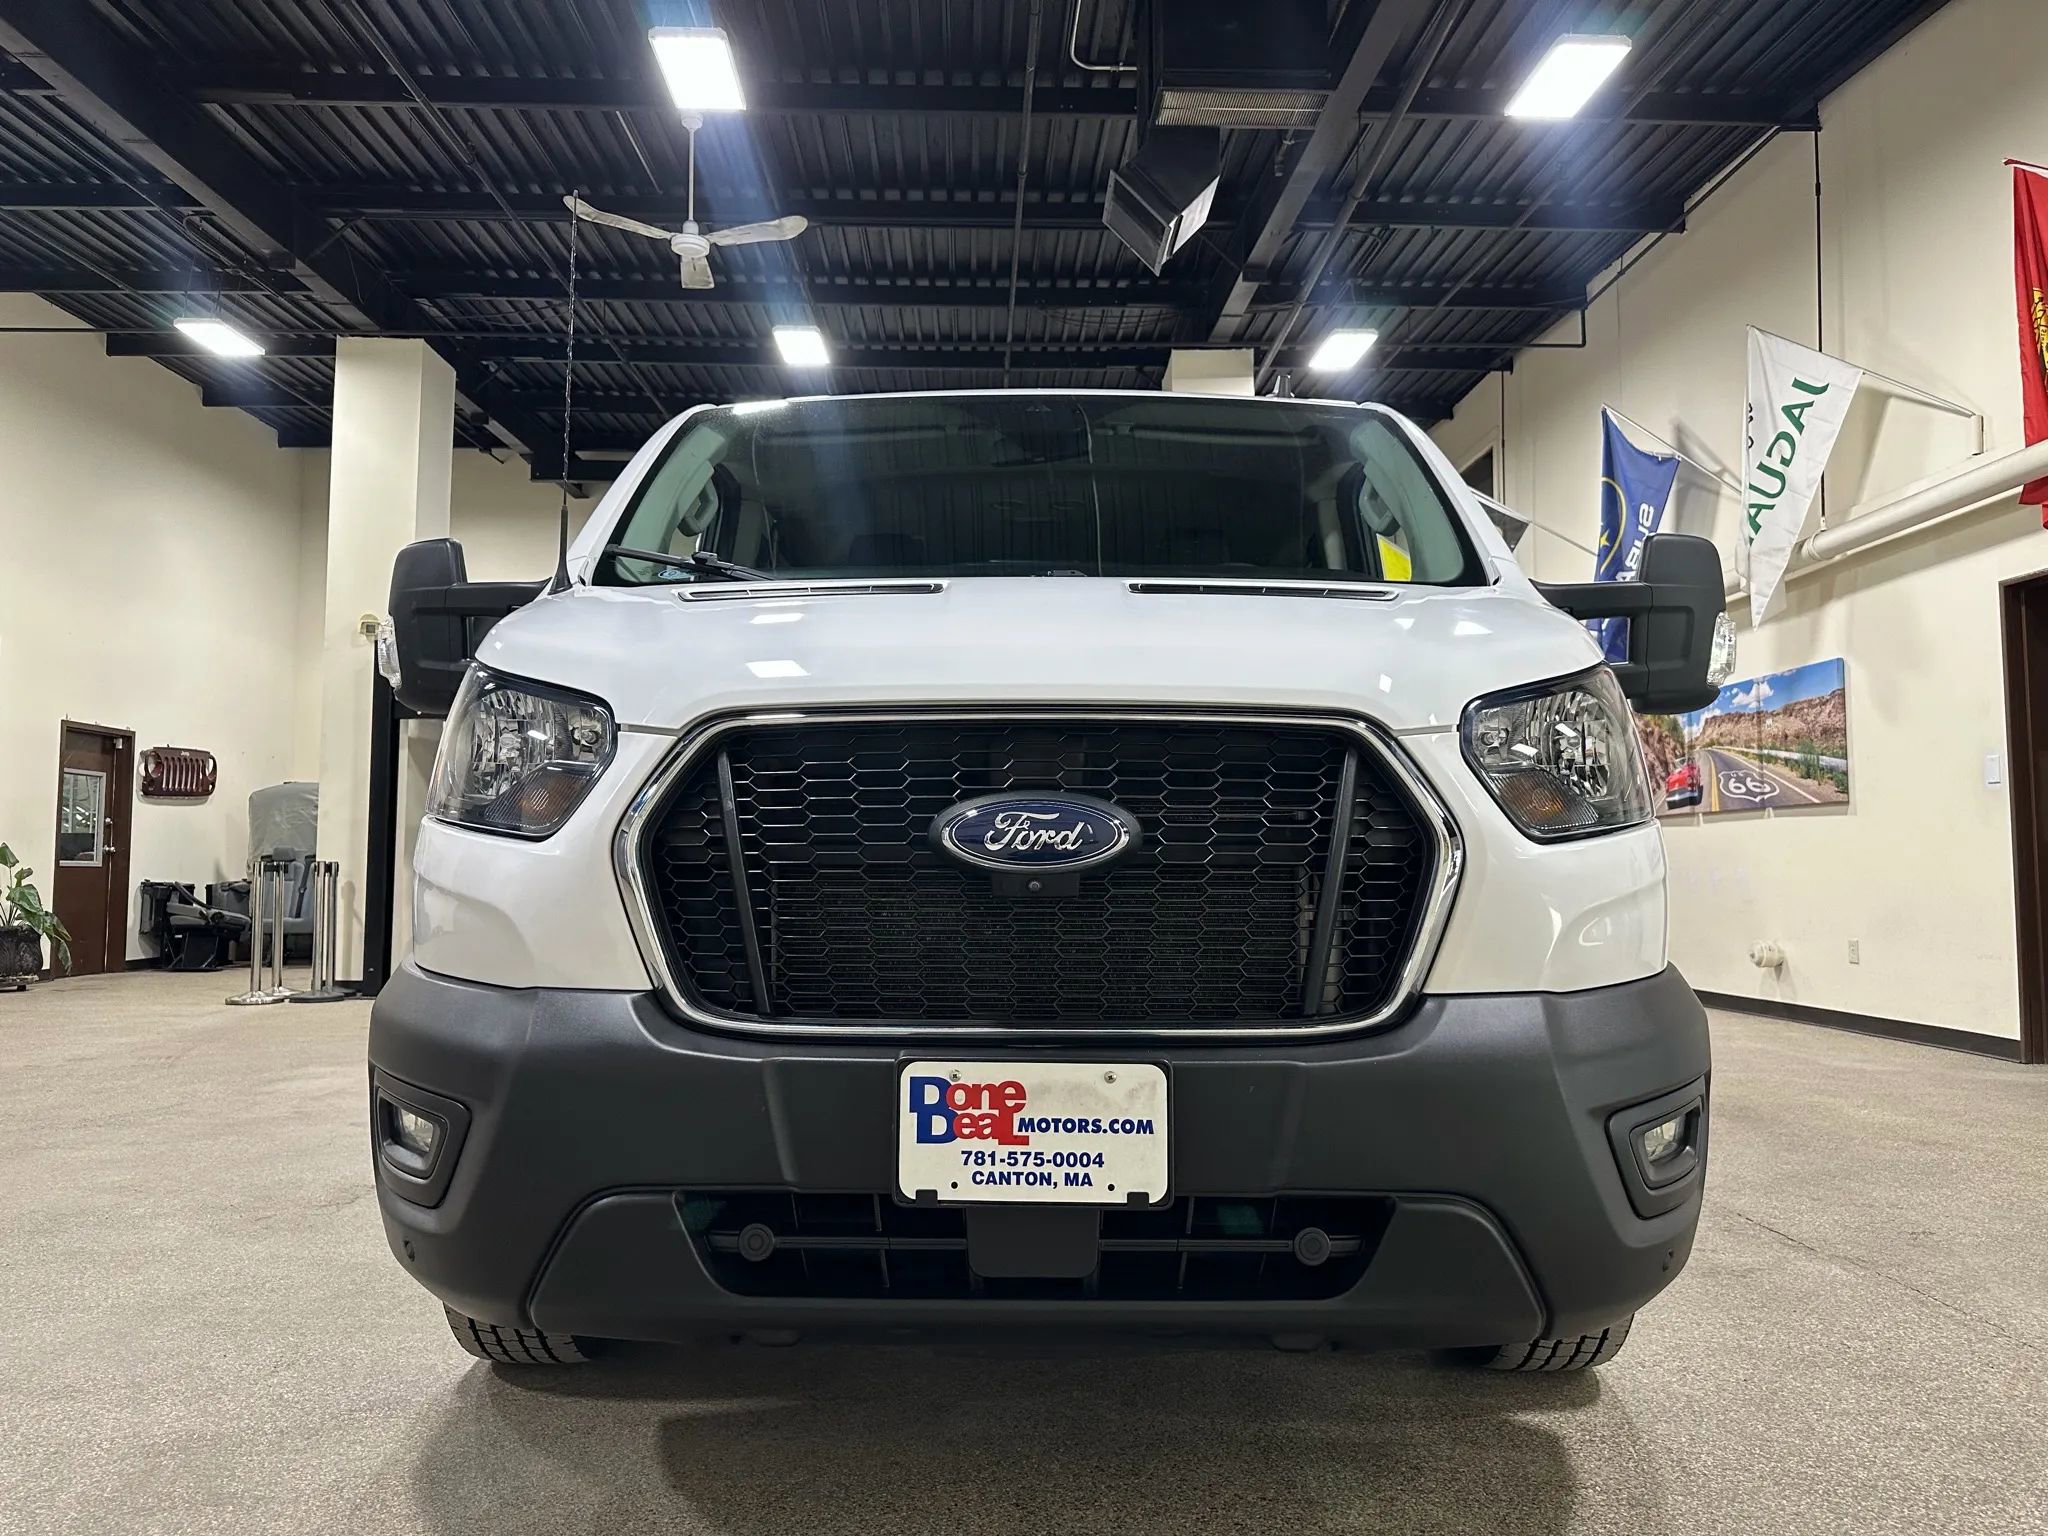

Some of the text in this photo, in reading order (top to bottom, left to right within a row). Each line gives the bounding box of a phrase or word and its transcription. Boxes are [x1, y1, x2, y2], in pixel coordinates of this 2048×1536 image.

[1728, 776, 1771, 794] 66
[983, 811, 1086, 851] Ford
[909, 1076, 1027, 1114] Done
[1017, 1117, 1155, 1135] MOTORS.COM
[960, 1150, 1105, 1169] 781-575-0004
[971, 1170, 1094, 1190] CANTON, MA
